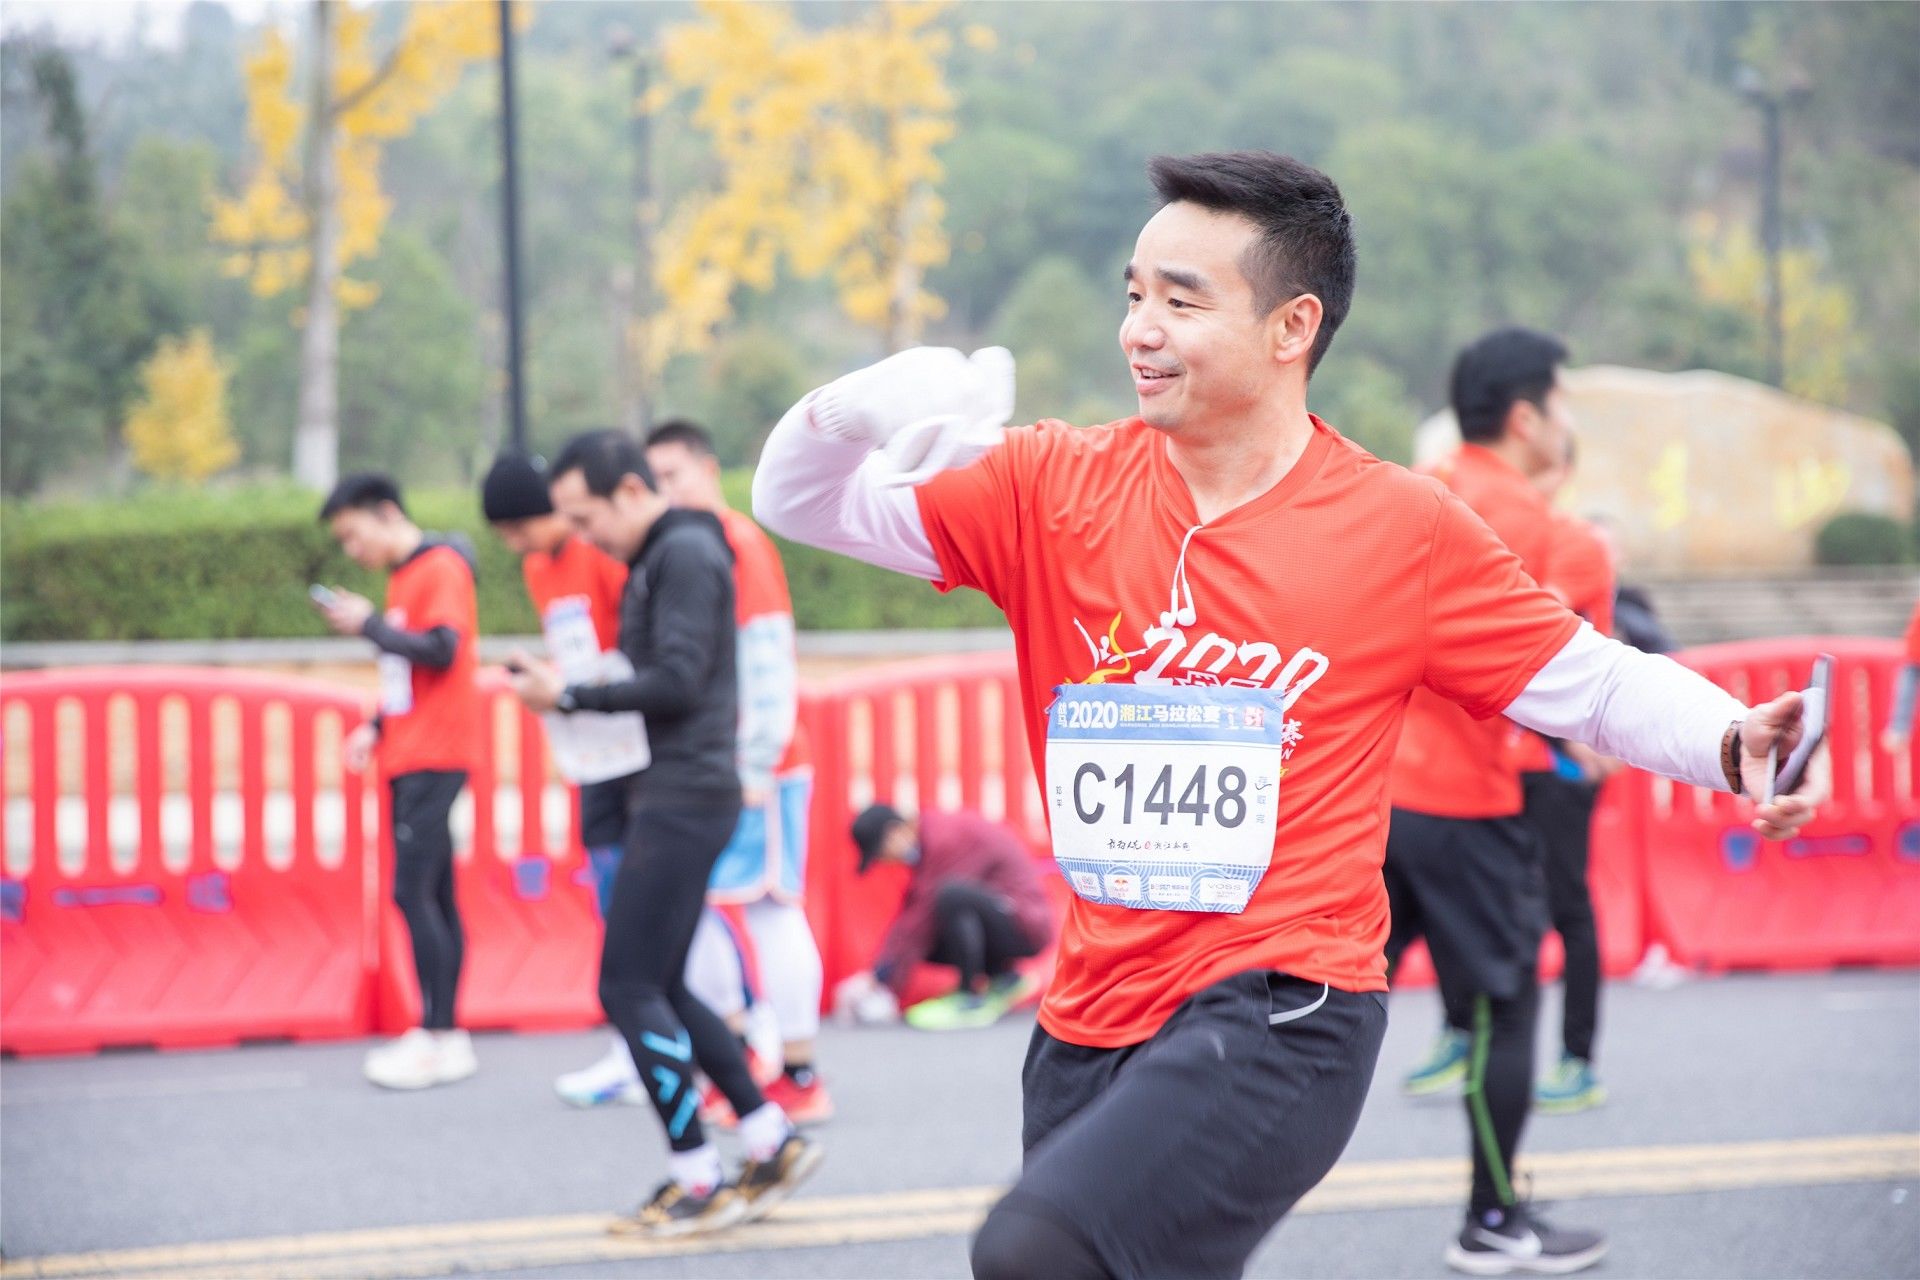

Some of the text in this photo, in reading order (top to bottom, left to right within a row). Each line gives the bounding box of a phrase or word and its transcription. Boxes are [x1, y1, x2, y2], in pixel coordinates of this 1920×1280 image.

[1068, 700, 1119, 729] 2020
[1120, 703, 1221, 723] 湘江马拉松赛
[1073, 761, 1247, 829] C1448
